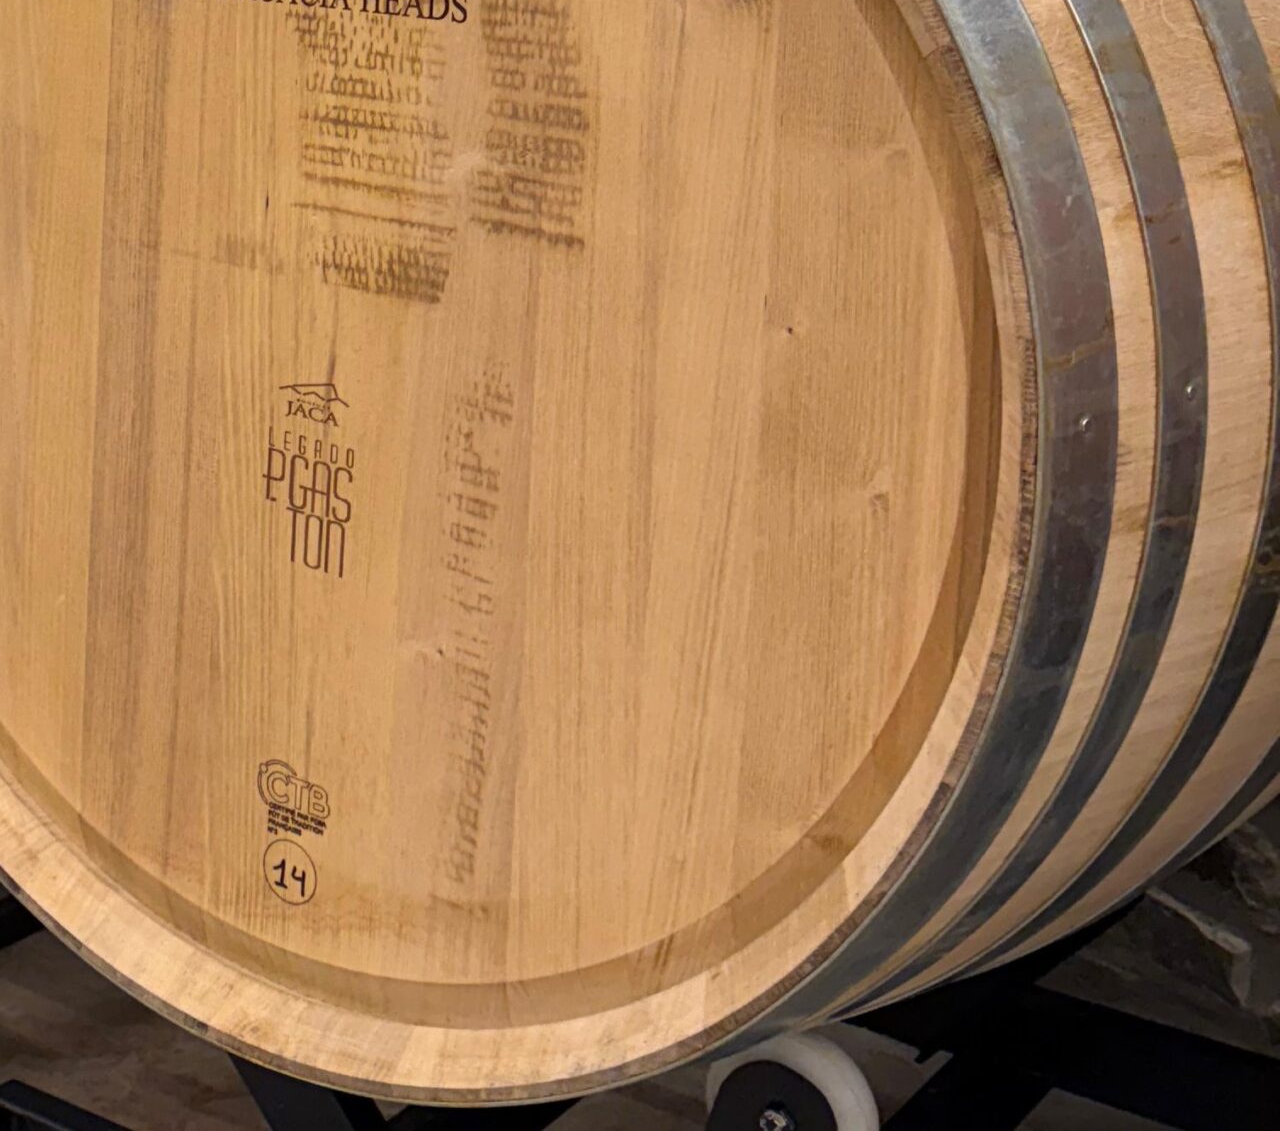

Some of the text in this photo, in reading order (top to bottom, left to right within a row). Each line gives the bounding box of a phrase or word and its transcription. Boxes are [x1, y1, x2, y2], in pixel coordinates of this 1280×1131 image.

[285, 400, 339, 427] JACA
[268, 426, 355, 468] LEGADO
[260, 765, 331, 820] CTB
[272, 858, 307, 897] 14
